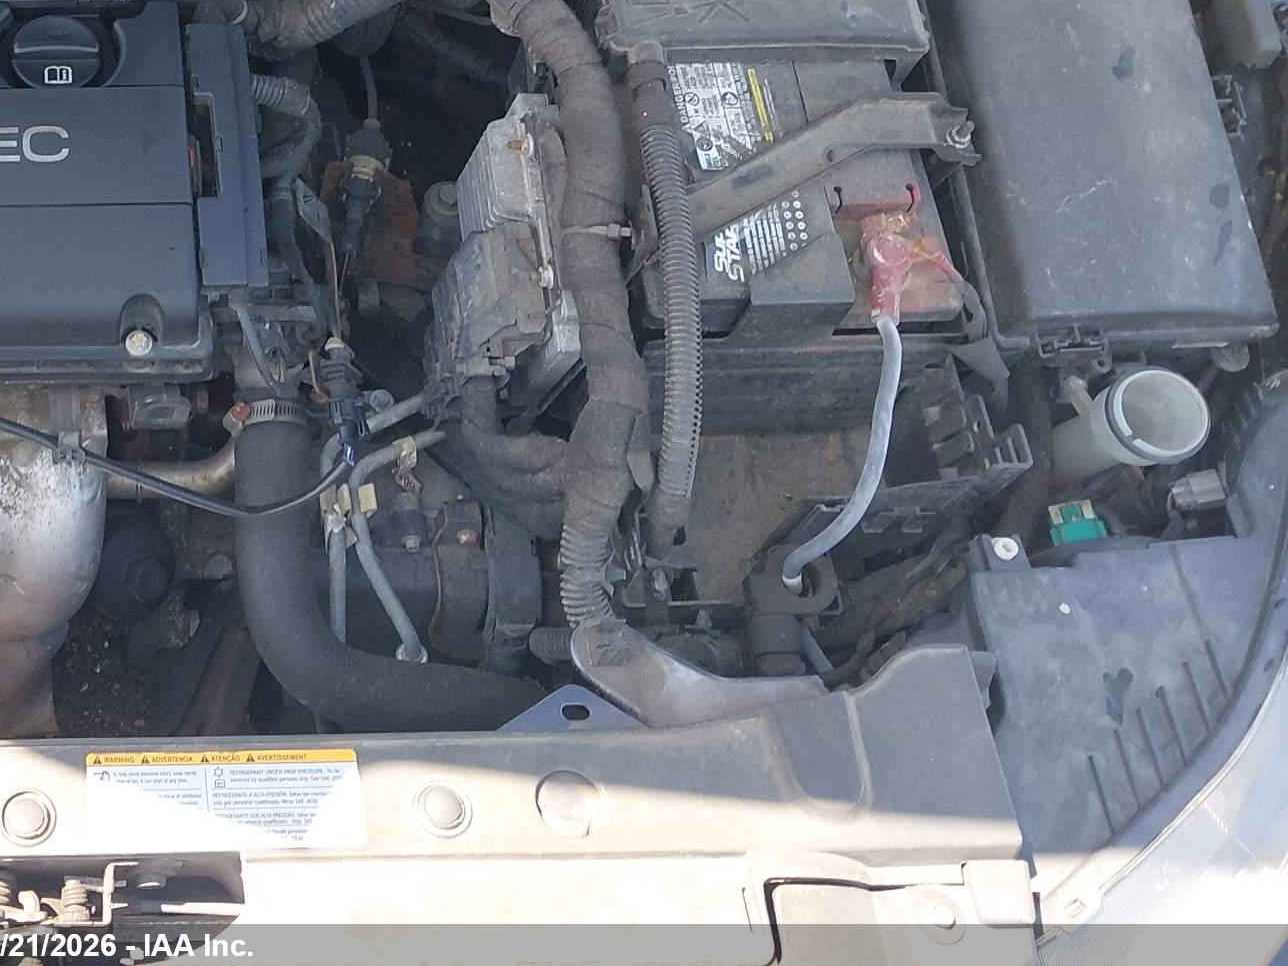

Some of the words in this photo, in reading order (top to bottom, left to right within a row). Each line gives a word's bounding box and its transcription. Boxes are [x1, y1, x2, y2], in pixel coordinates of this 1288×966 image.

[672, 82, 689, 124] DANGER
[103, 756, 135, 764] WARNING
[151, 755, 194, 763] ADVERTENCIA
[210, 753, 241, 763] ATENÇÃO
[257, 753, 307, 762] AVERTISSEMENT
